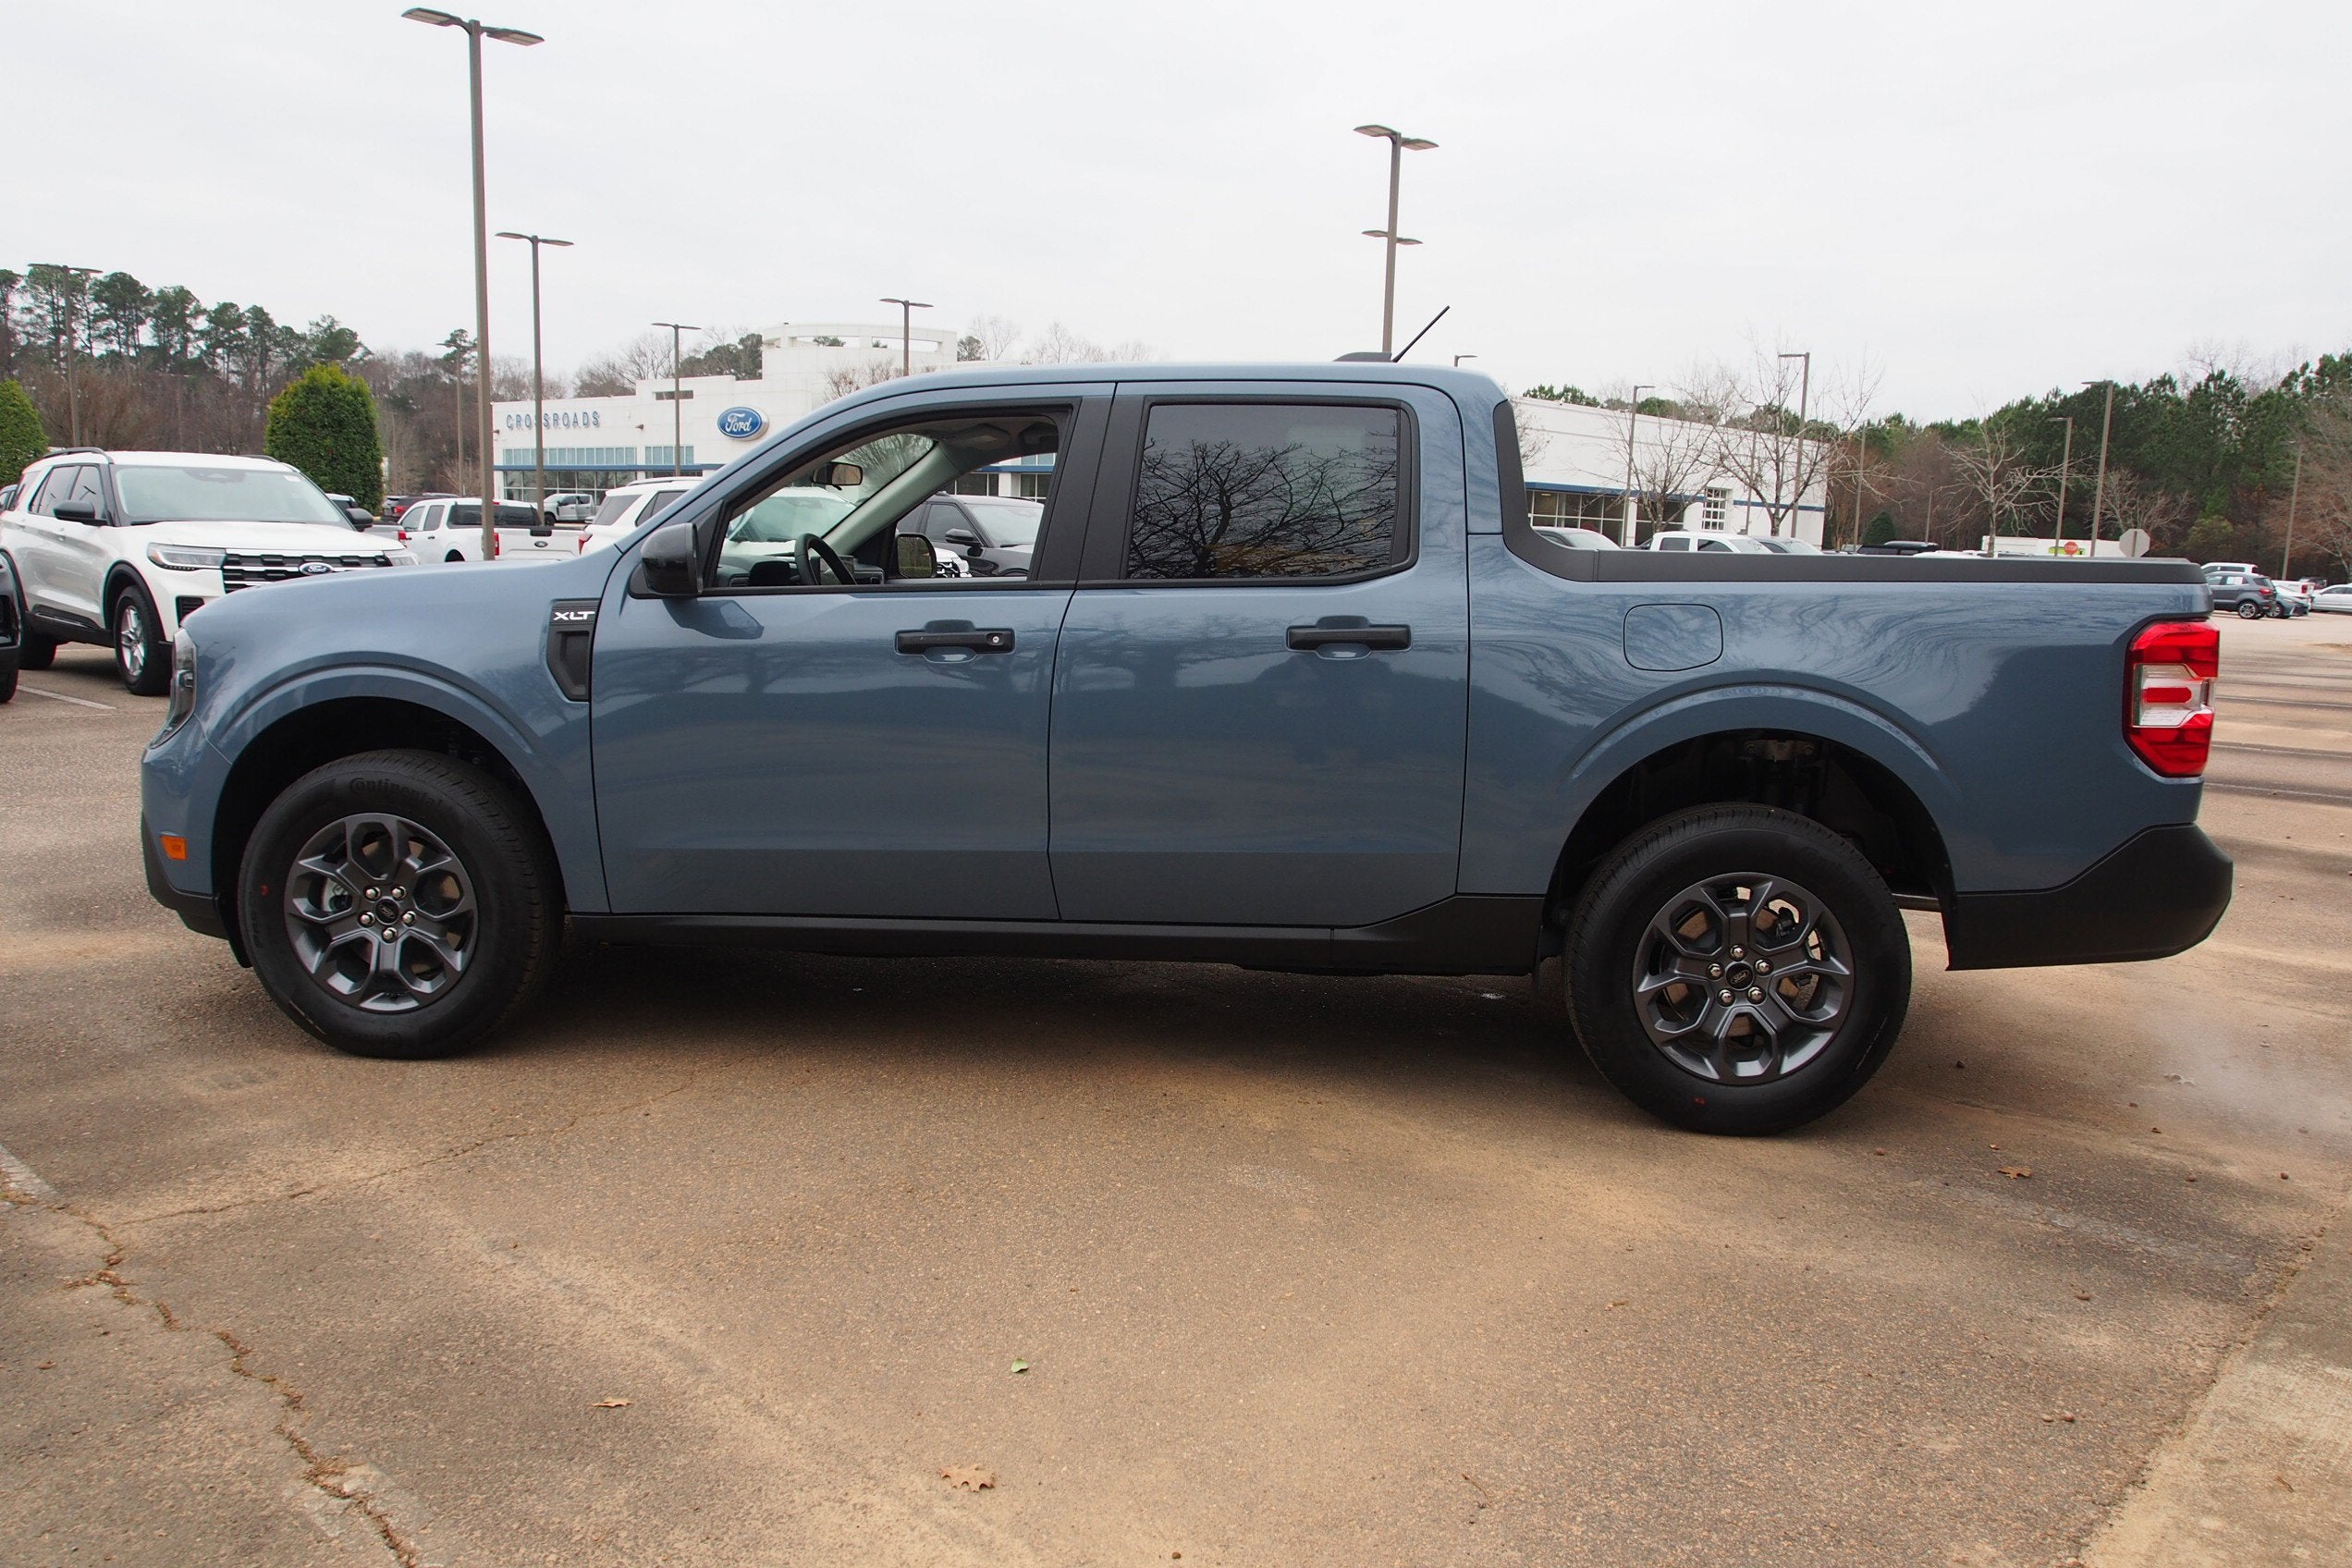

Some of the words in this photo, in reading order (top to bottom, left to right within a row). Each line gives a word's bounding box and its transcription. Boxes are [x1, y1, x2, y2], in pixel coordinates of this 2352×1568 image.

[506, 410, 600, 429] CROSROADS
[725, 412, 753, 433] Ford
[553, 611, 595, 620] XLT
